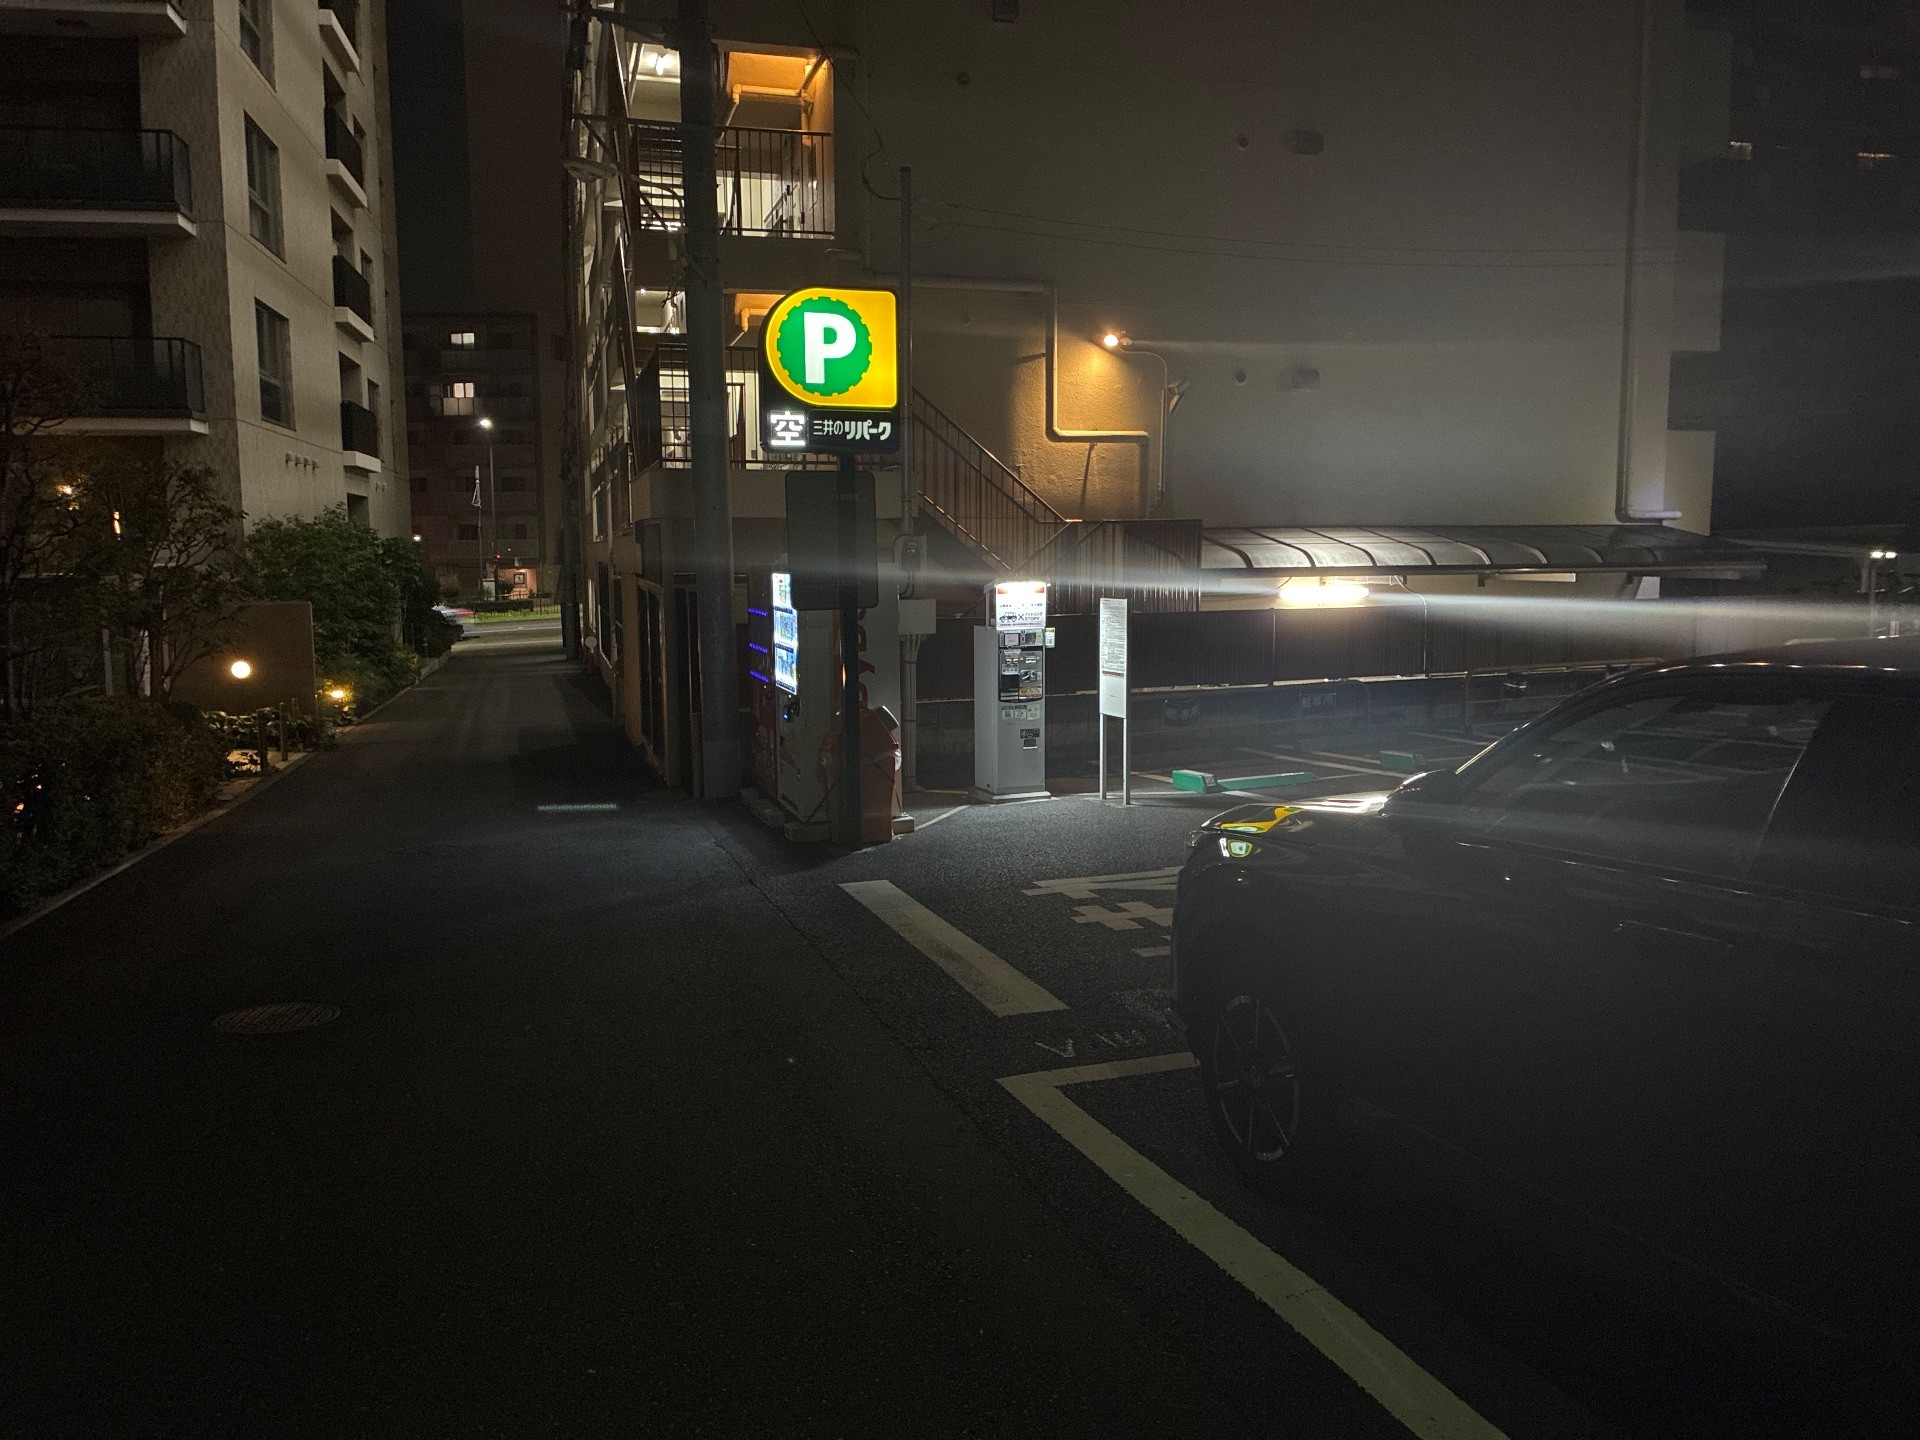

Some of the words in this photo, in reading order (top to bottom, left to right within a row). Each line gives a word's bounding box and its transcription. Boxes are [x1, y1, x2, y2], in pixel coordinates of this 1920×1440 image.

[804, 311, 857, 384] P
[770, 410, 806, 446] 空
[813, 419, 892, 441] 三井のリパーク
